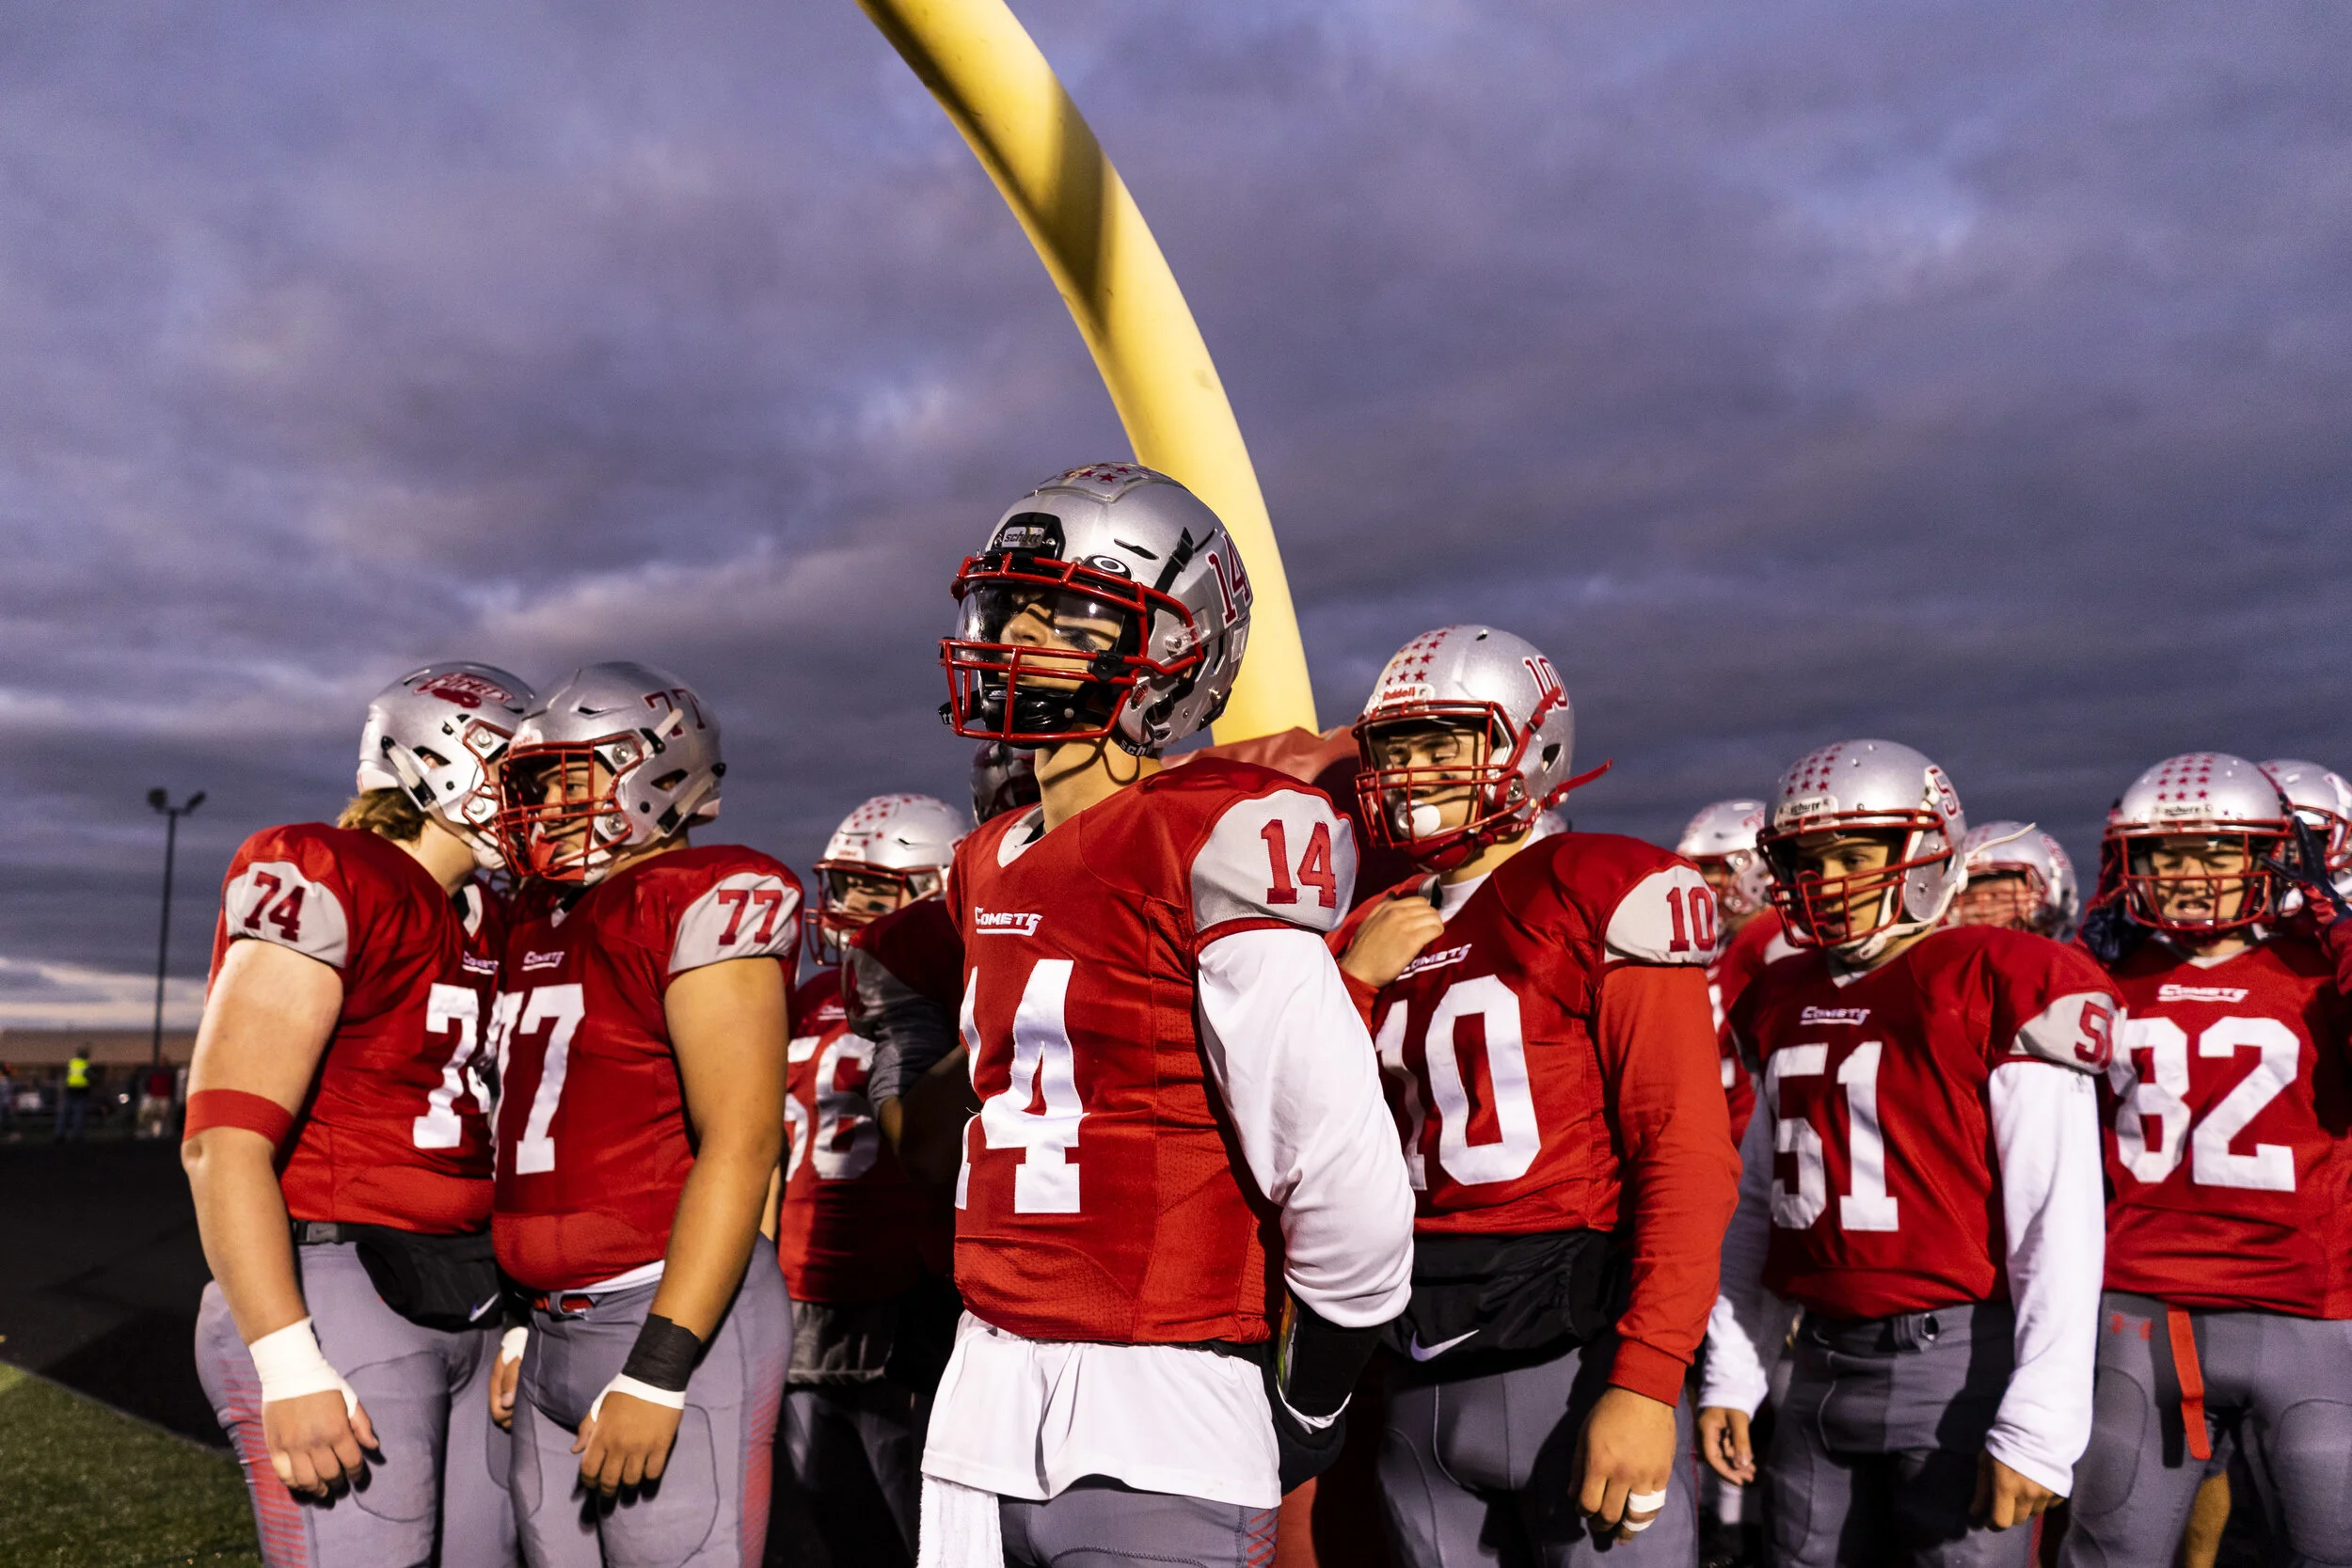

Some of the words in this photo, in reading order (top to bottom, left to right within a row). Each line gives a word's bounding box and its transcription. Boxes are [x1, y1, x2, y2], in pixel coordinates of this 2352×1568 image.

[1205, 531, 1252, 629] 14
[642, 688, 707, 739] 77
[1521, 655, 1569, 714] 10
[1261, 818, 1336, 910] 14
[244, 870, 306, 942] 74
[718, 889, 784, 945] 77
[975, 907, 1043, 936] COMETS
[1666, 887, 1716, 952] 10
[1398, 943, 1472, 979] OMETS
[1375, 974, 1542, 1186] 10
[2107, 1016, 2301, 1192] 82
[1765, 1040, 1899, 1232] 51
